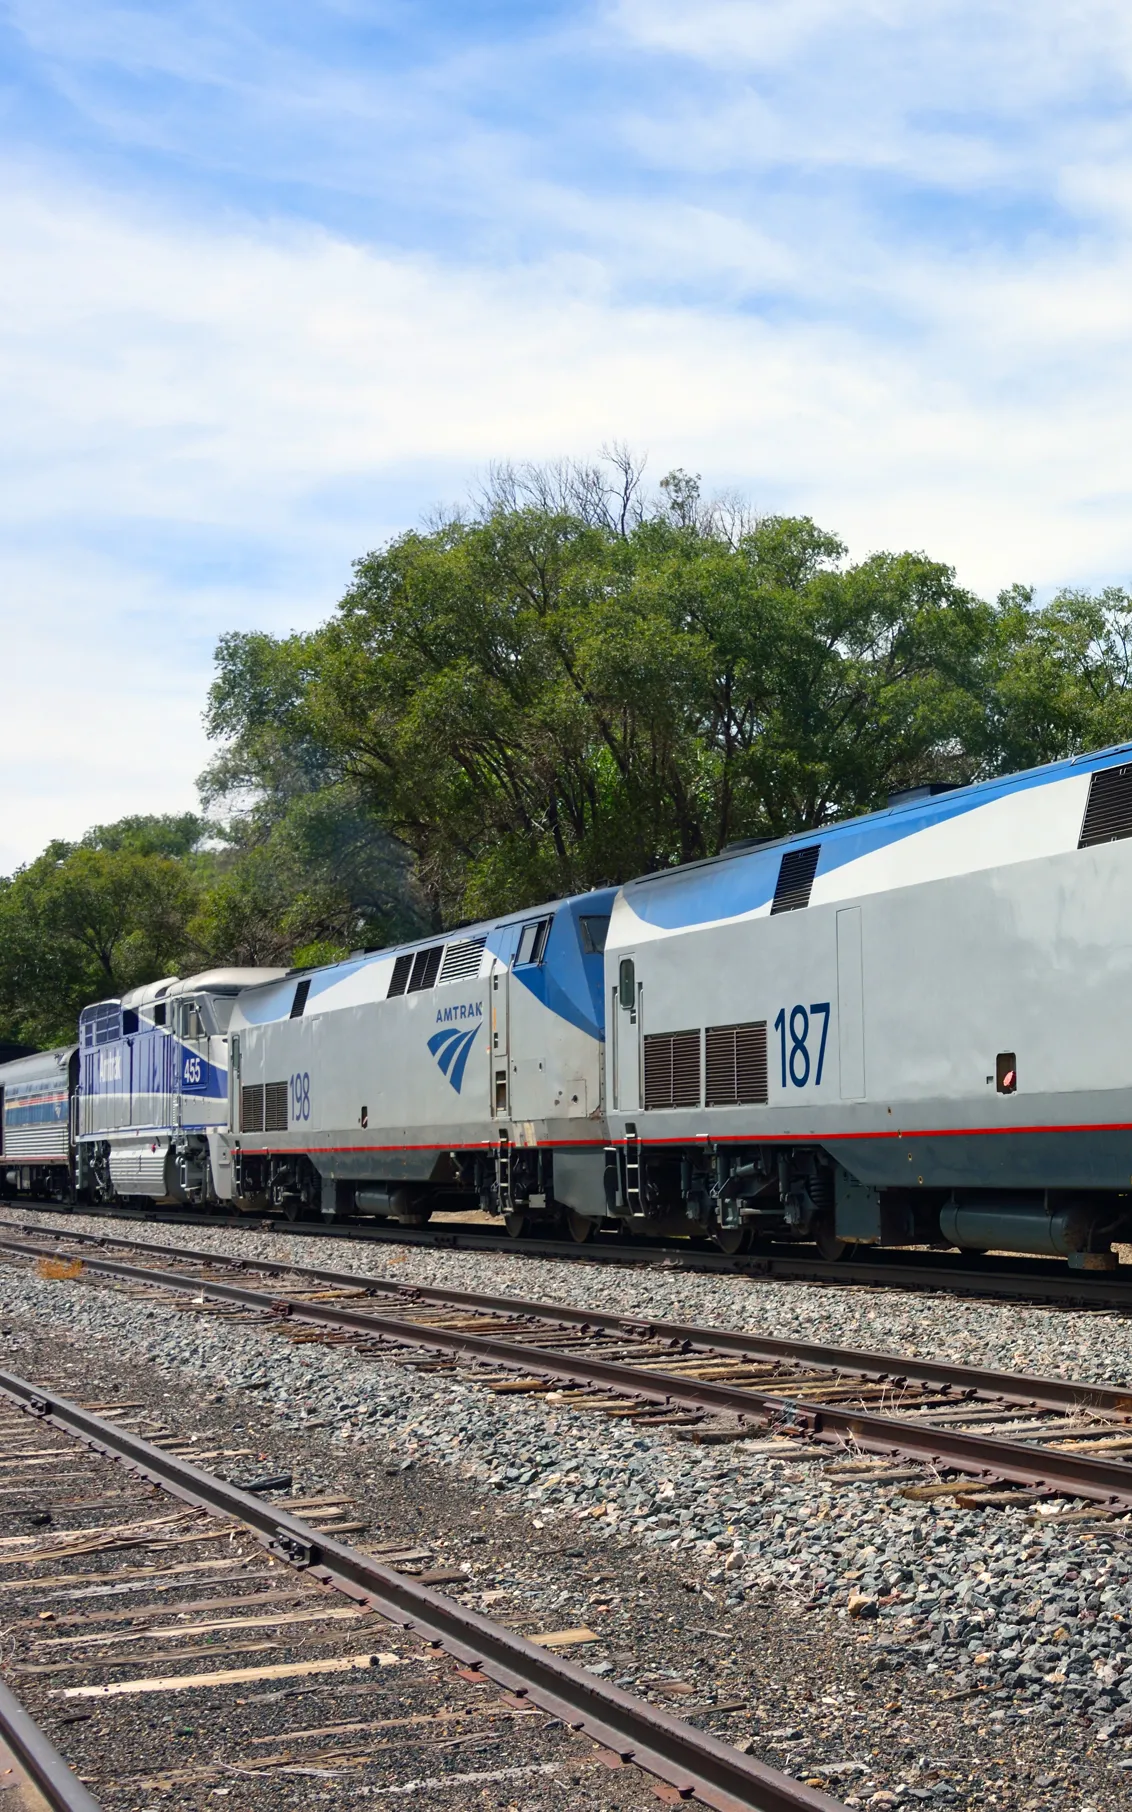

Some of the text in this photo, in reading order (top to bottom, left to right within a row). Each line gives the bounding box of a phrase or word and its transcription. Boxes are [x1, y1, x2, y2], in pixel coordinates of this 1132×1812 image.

[436, 1001, 483, 1023] AMTRAK
[774, 1002, 830, 1088] 187
[184, 1058, 201, 1083] 455
[289, 1071, 310, 1121] 198
